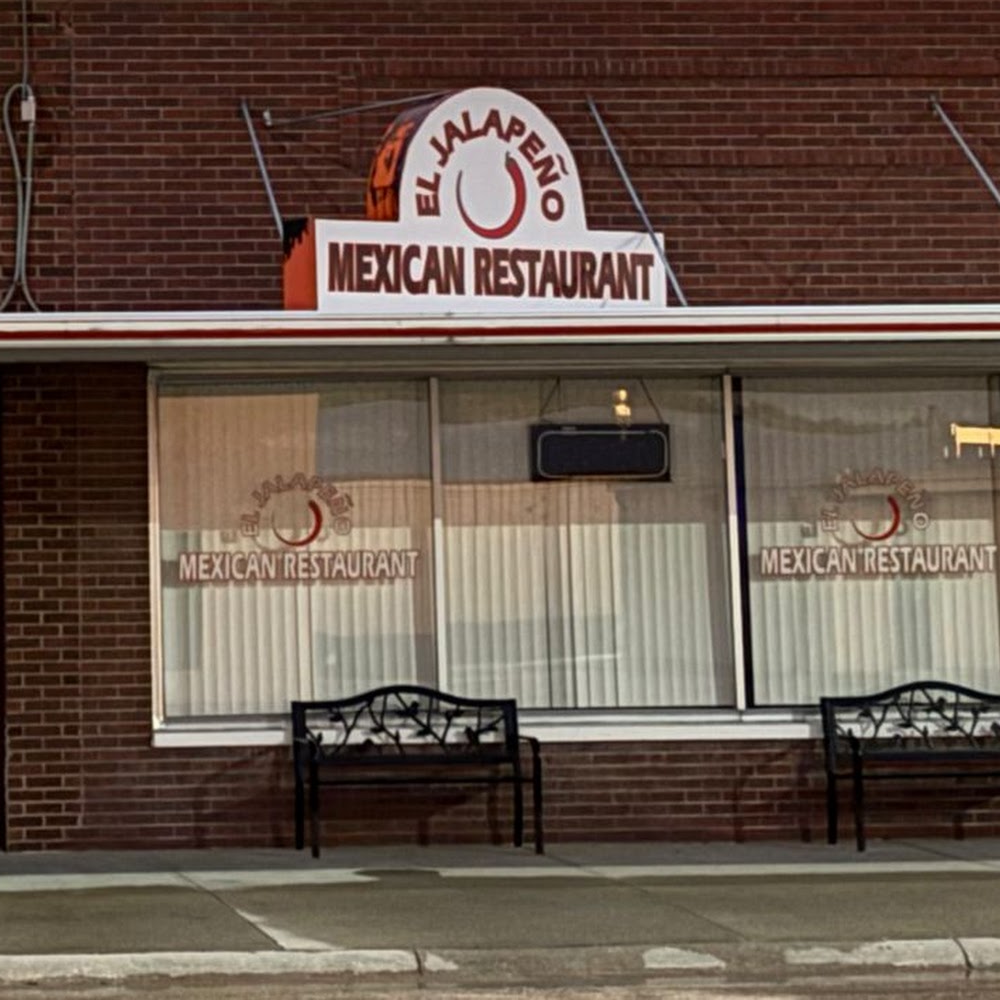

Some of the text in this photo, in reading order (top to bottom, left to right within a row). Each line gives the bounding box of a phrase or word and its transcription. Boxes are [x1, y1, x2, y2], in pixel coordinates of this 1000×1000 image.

[416, 108, 570, 222] EL JALAPEÑO
[327, 242, 654, 301] MEXICAN RESTAURANT
[179, 550, 419, 581] MEXICAN RESTAURANT
[761, 545, 998, 576] MEXICAN RESTAURANT
